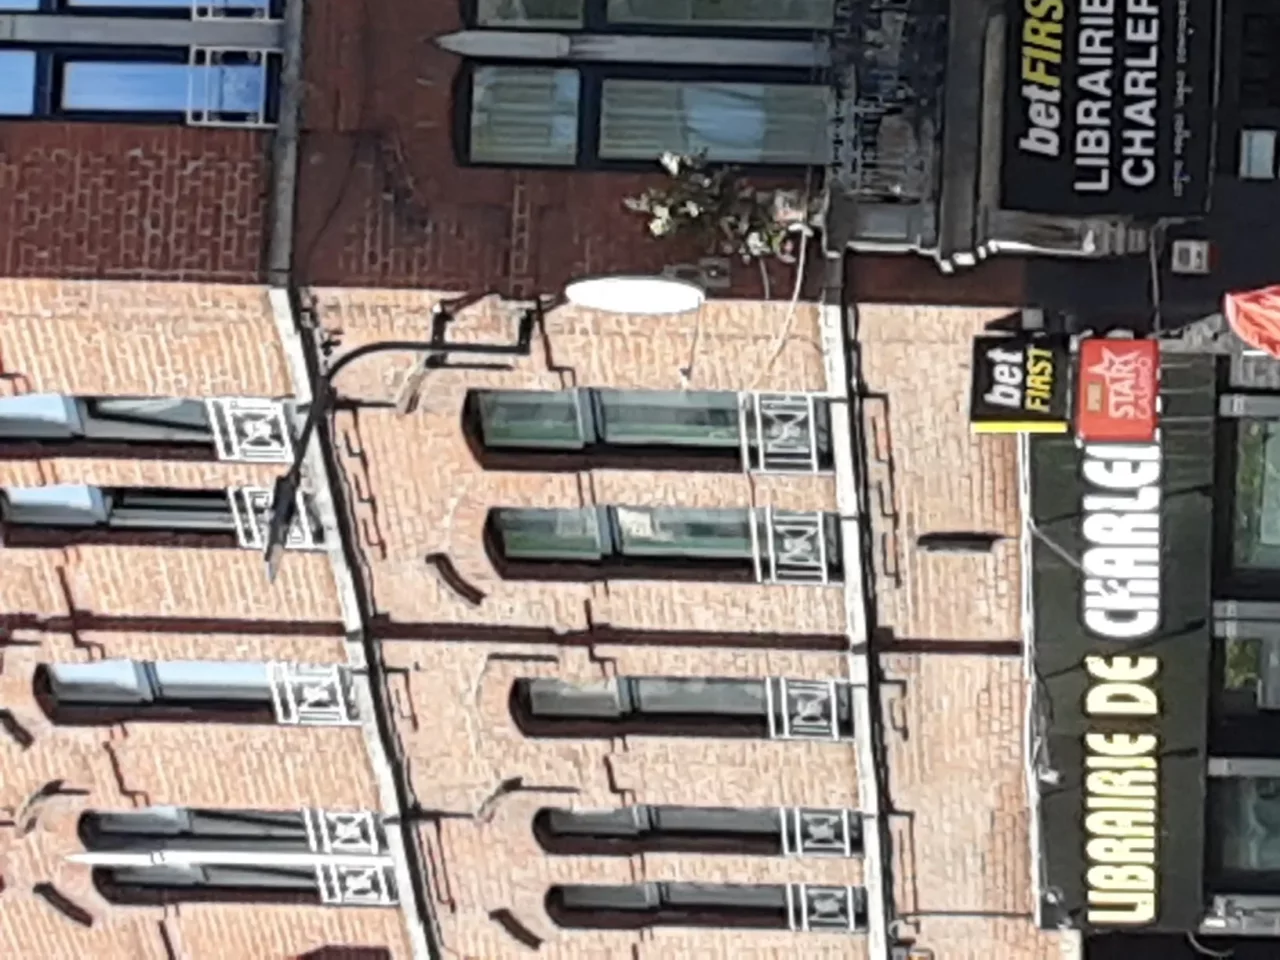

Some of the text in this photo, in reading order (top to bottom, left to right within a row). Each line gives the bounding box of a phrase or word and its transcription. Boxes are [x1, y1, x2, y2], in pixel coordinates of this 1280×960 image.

[983, 347, 1024, 407] bet
[1024, 344, 1054, 413] FIRST
[1107, 358, 1136, 419] STAR
[1085, 656, 1158, 714] DE
[1085, 733, 1156, 923] LIBRAIRIE
